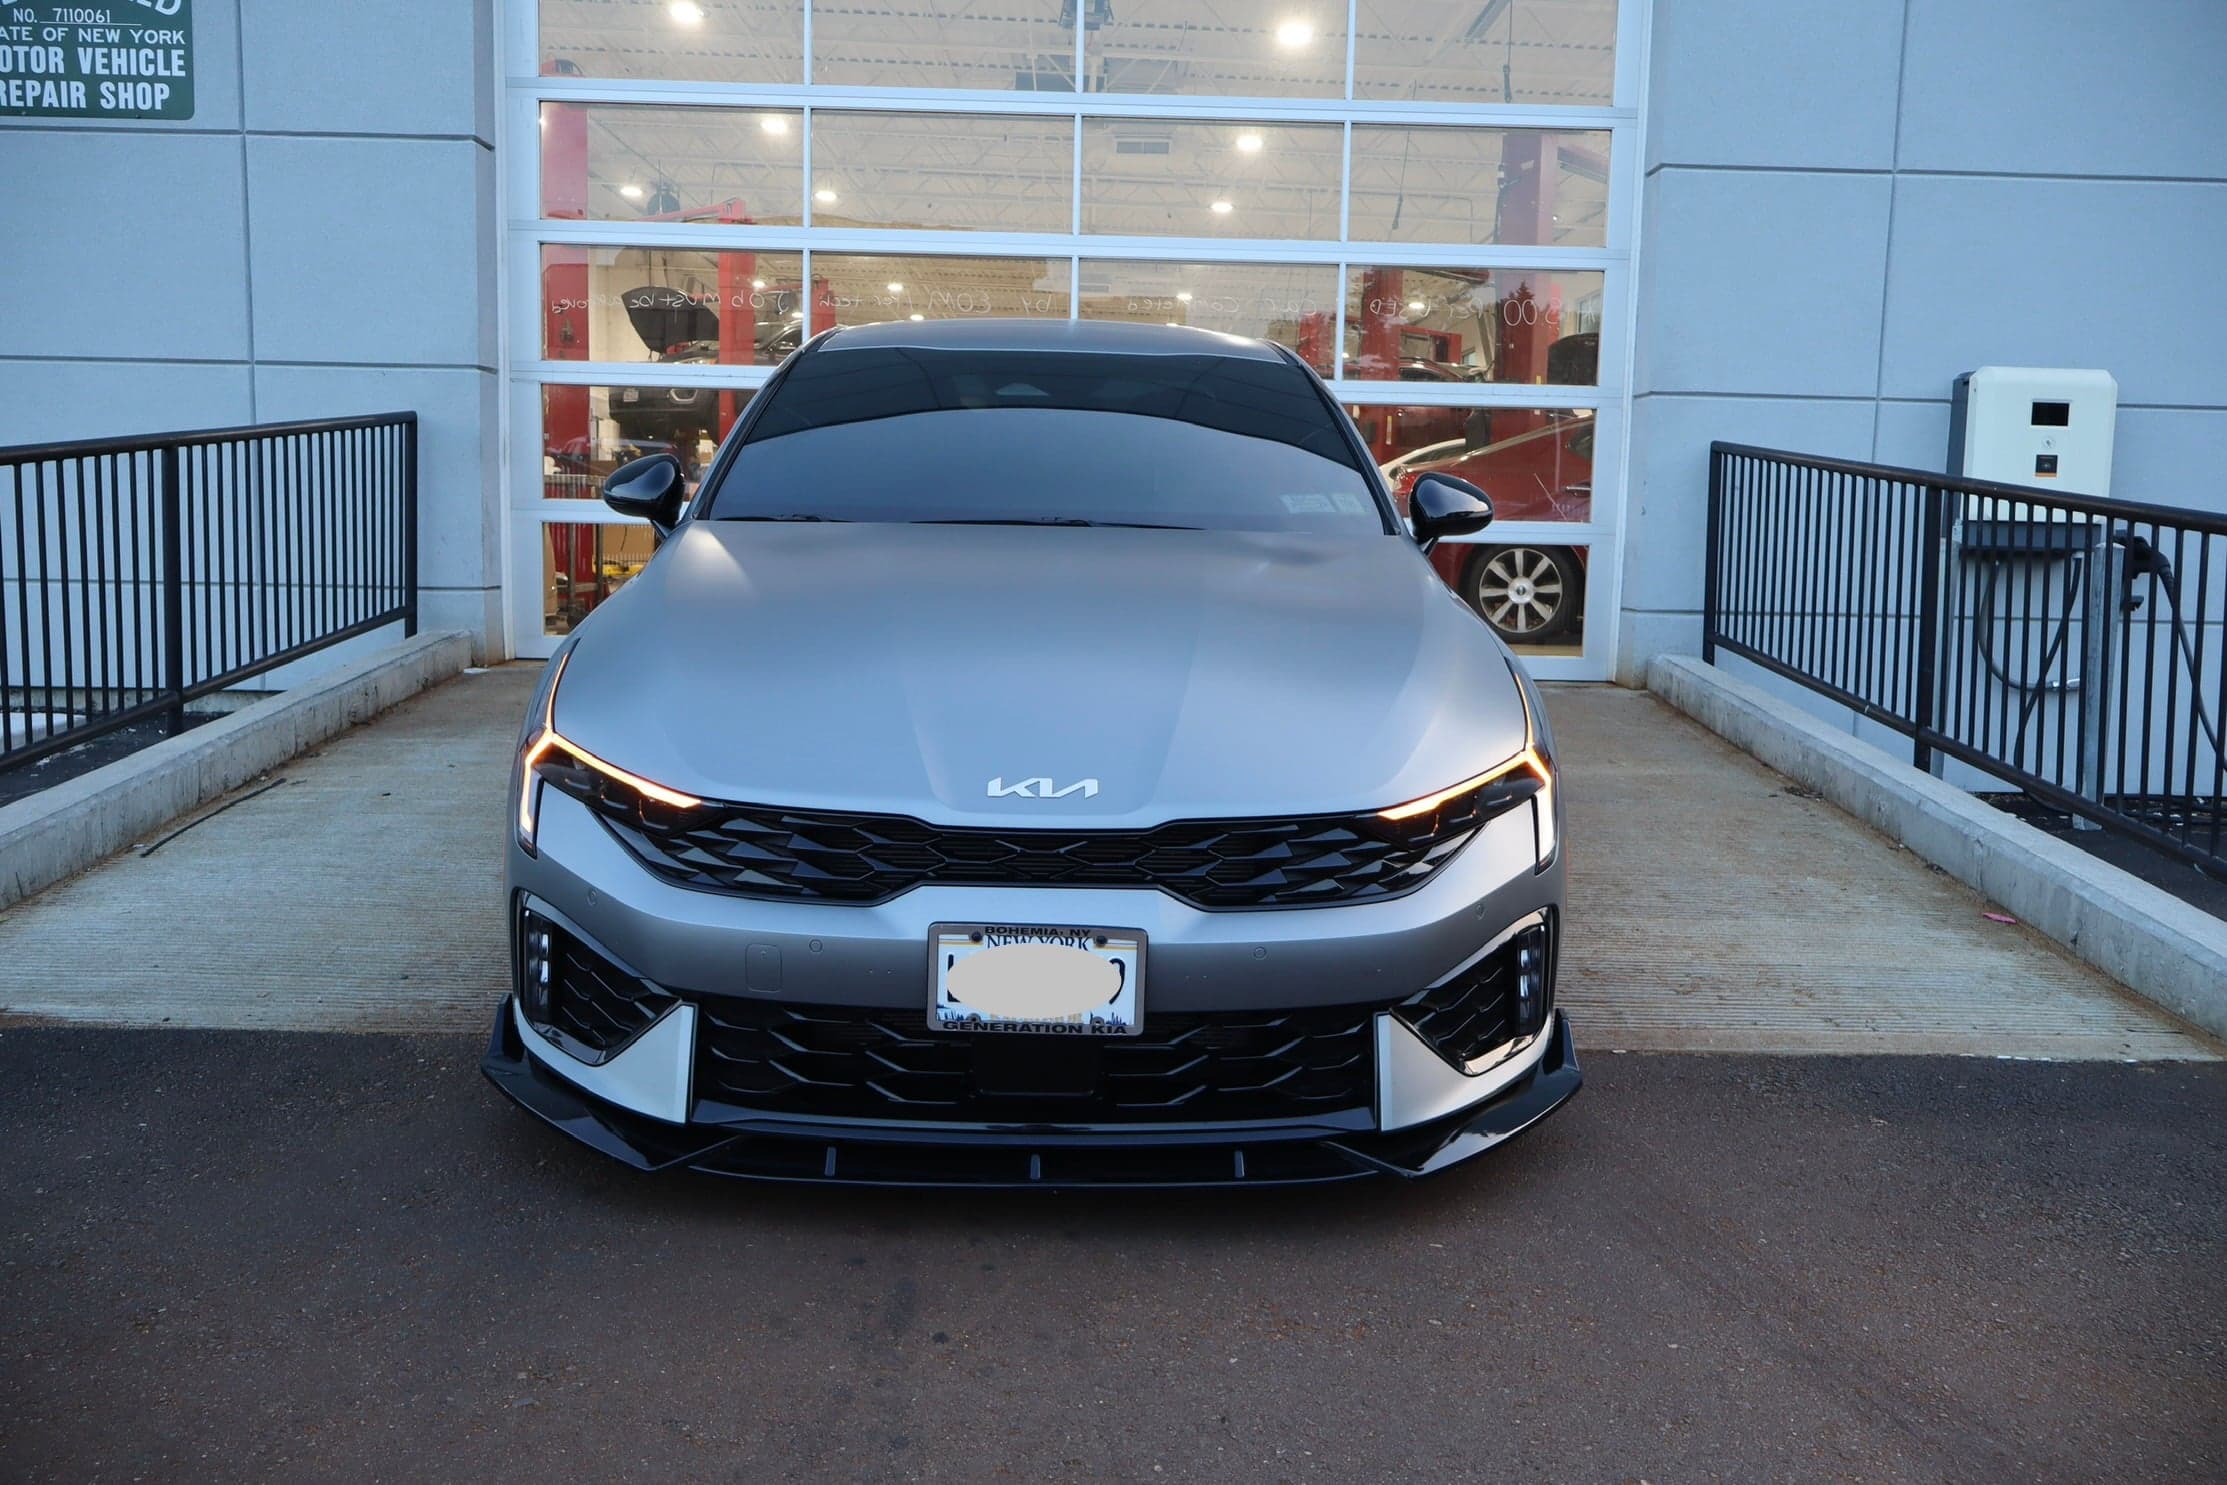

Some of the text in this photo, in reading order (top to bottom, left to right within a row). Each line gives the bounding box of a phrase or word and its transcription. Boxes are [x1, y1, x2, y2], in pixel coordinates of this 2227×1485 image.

[13, 8, 38, 23] NO.
[52, 8, 111, 24] 7110061
[42, 27, 69, 42] OF
[78, 28, 120, 43] NEW
[130, 29, 186, 45] YORK
[77, 47, 186, 76] VEHICLE
[100, 81, 170, 110] SHOP
[987, 776, 1099, 799] KIA
[1069, 928, 1091, 938] NY
[942, 1021, 1128, 1035] GENERATION KIA
